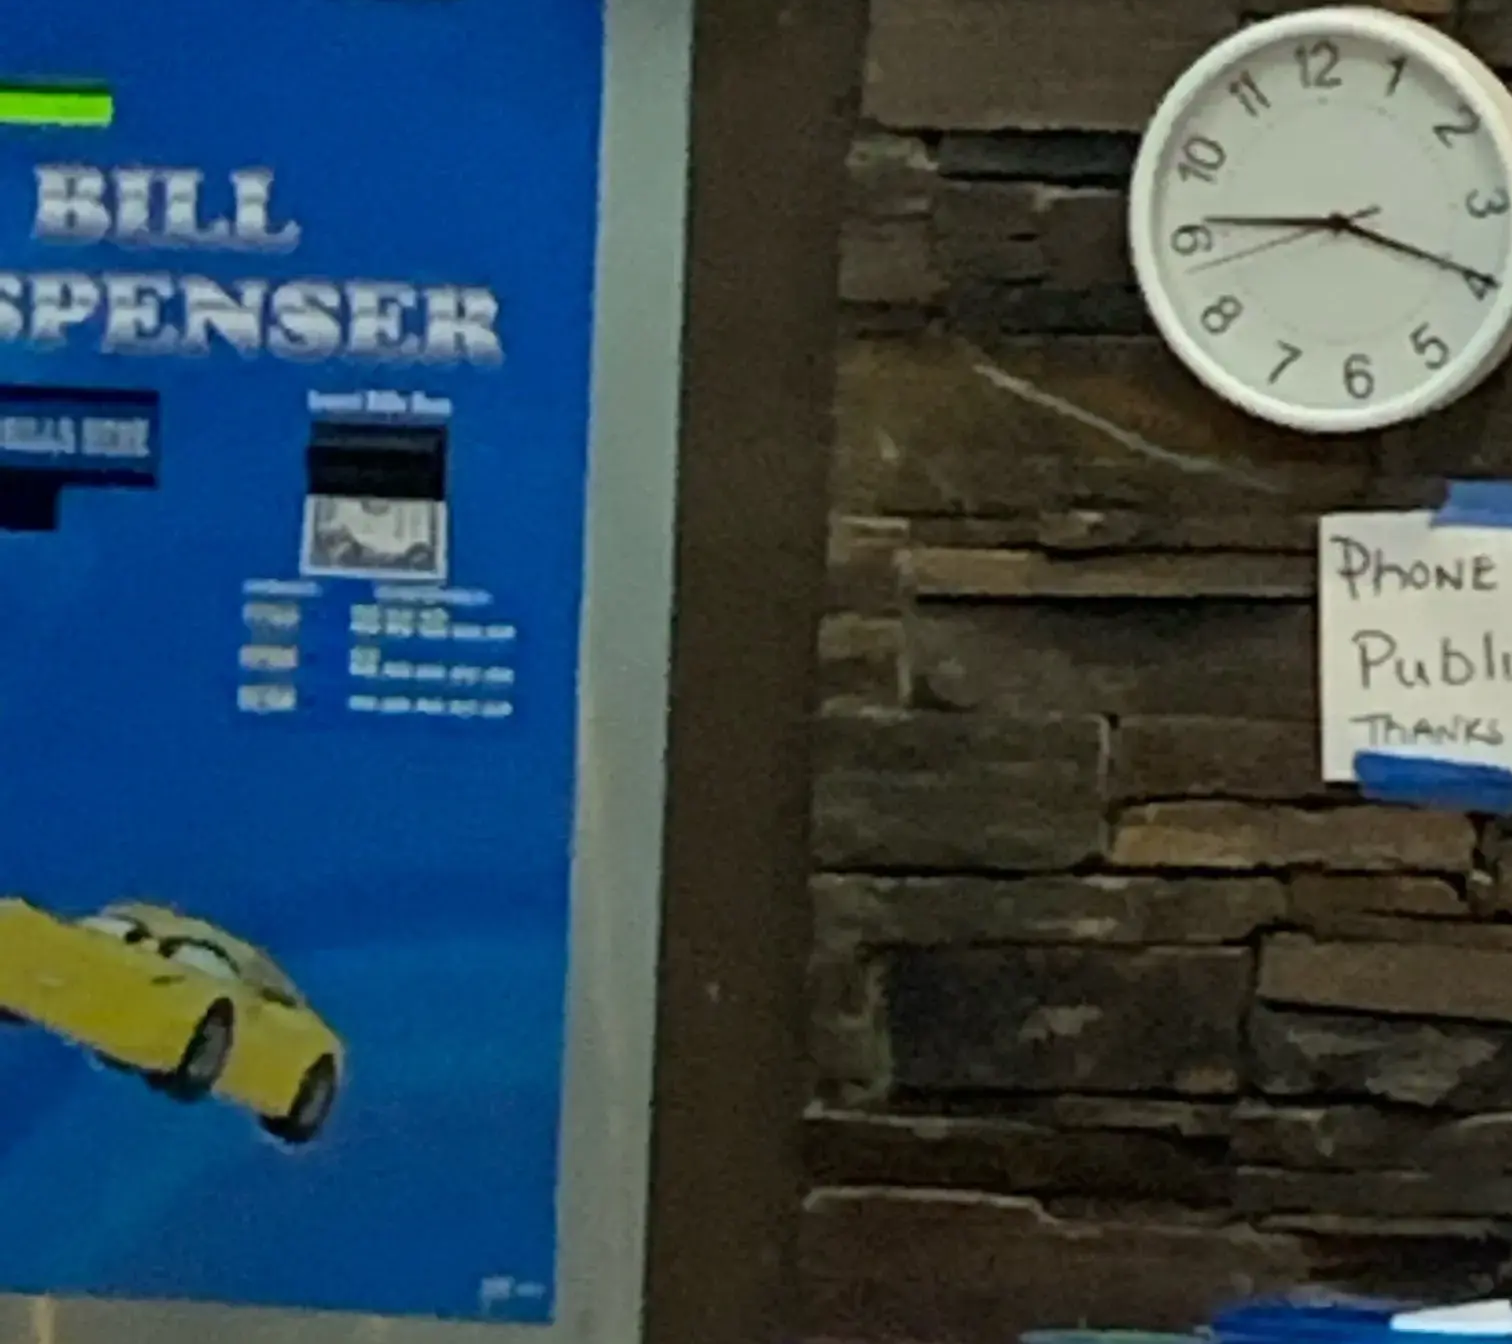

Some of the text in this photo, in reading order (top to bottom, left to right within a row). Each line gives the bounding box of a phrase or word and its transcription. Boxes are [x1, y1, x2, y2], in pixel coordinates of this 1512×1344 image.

[1294, 39, 1341, 89] 12
[1384, 55, 1407, 97] 1
[1228, 70, 1271, 117] 11
[1432, 103, 1482, 149] 2
[1176, 136, 1228, 184] 10
[32, 163, 303, 253] BILL
[1464, 186, 1511, 220] 3
[1170, 223, 1213, 256] 9
[1200, 294, 1243, 336] 8
[1267, 339, 1303, 385] 7
[1409, 322, 1449, 371] 5
[1342, 353, 1375, 400] 6
